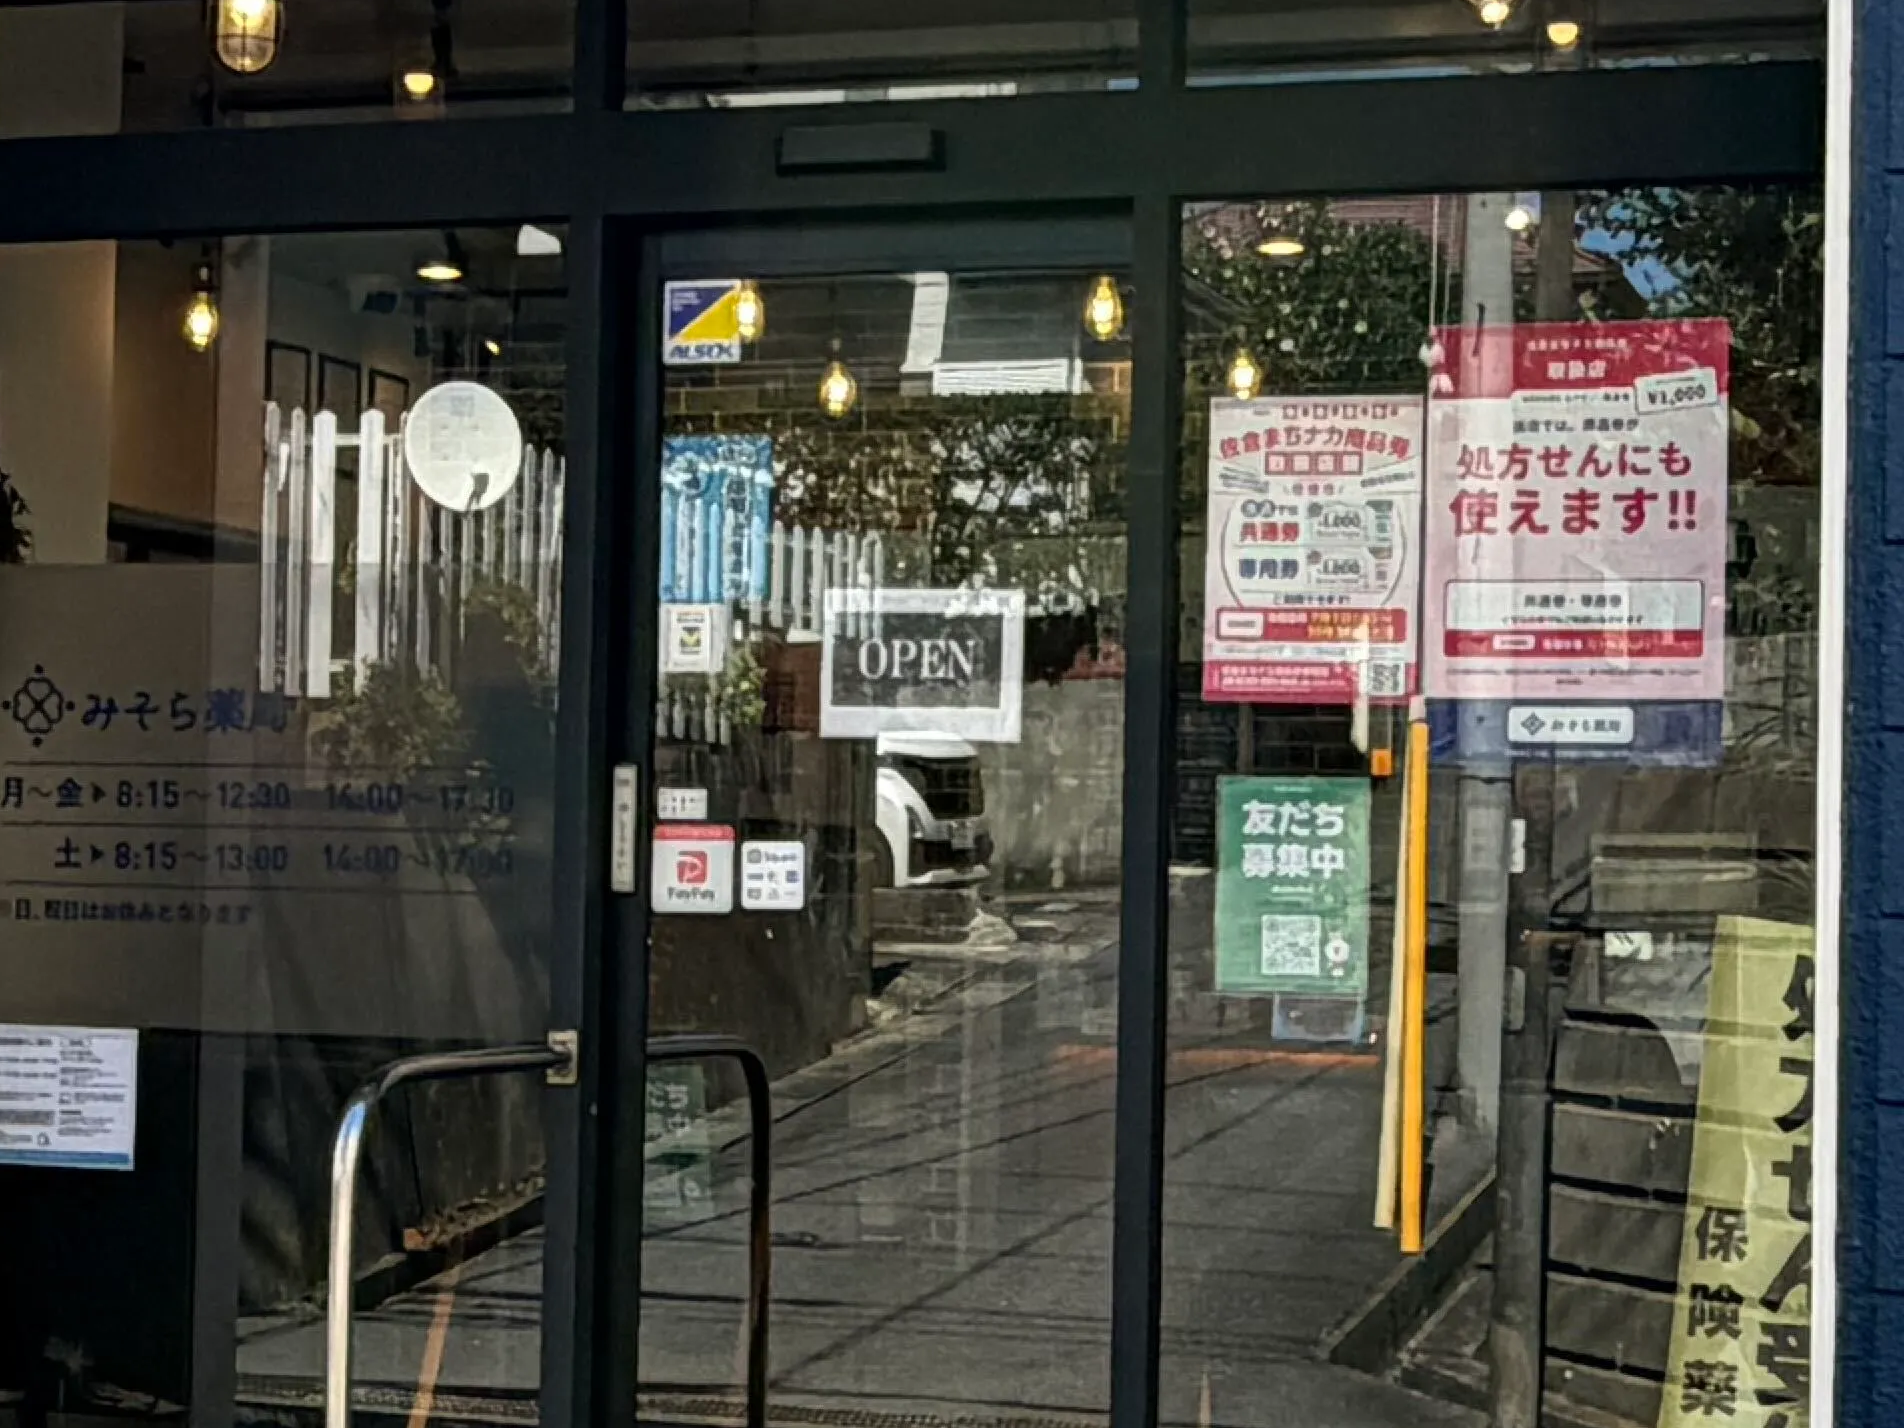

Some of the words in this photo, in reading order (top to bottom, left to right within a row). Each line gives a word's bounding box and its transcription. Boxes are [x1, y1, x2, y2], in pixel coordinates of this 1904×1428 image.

[1456, 441, 1693, 480] 処方せんにも
[859, 638, 976, 682] OPEN
[1242, 799, 1345, 837] 友だち
[1242, 843, 1346, 880] 募集中
[667, 886, 716, 902] PayPay
